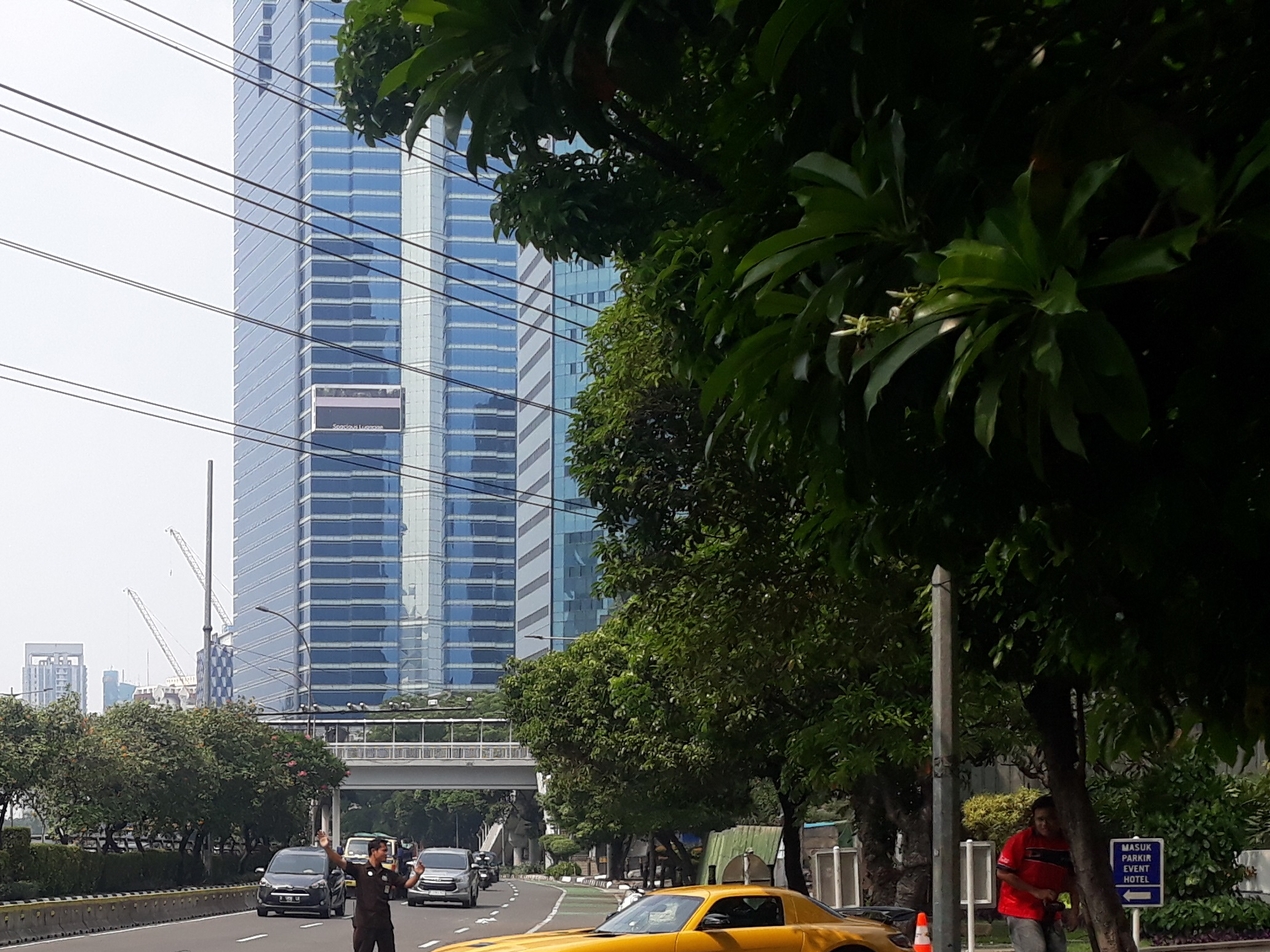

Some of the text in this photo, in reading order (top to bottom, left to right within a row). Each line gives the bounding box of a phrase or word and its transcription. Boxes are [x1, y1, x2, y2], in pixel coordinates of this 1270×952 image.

[1122, 854, 1151, 862] PARKIR
[1123, 865, 1150, 873] EVENT
[1123, 875, 1149, 883] HOTEL
